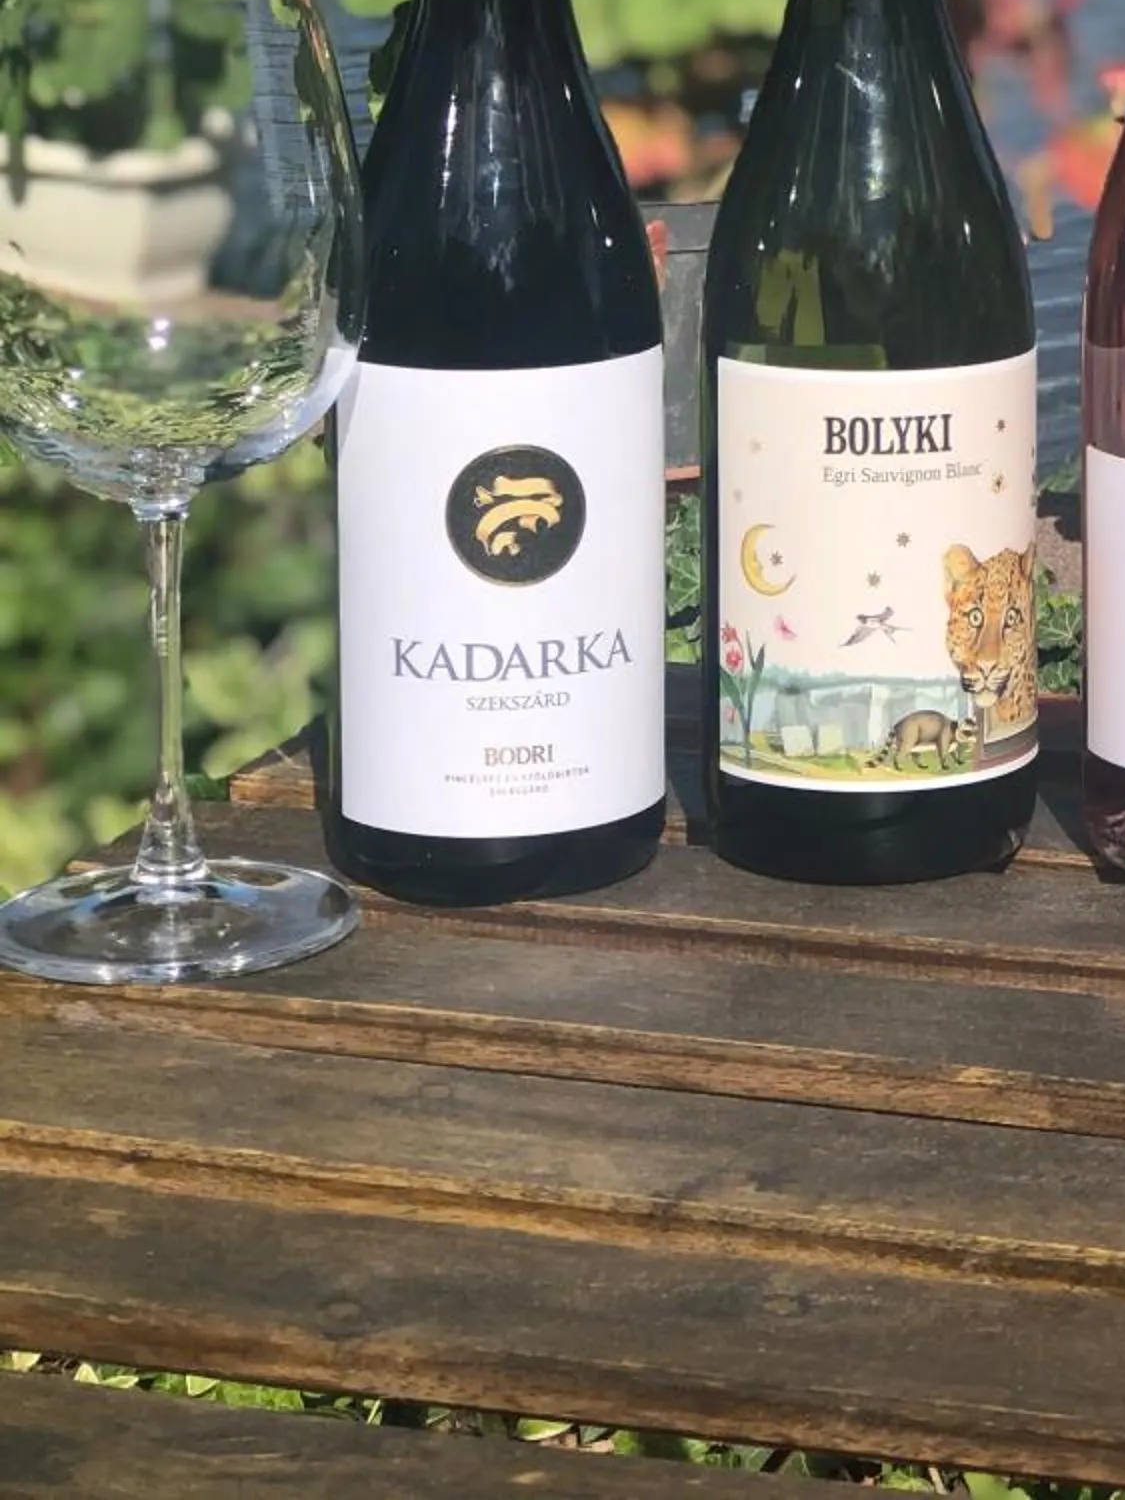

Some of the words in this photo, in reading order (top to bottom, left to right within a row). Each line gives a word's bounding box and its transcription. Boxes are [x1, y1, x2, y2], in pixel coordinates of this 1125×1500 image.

[822, 413, 953, 456] BOLYKI
[822, 466, 857, 487] Egri
[860, 465, 942, 487] Sauvignon
[945, 462, 983, 480] Blanc
[391, 628, 632, 683] KADARKA
[465, 690, 571, 712] SZEKSZÁRD
[484, 744, 554, 767] BODRI
